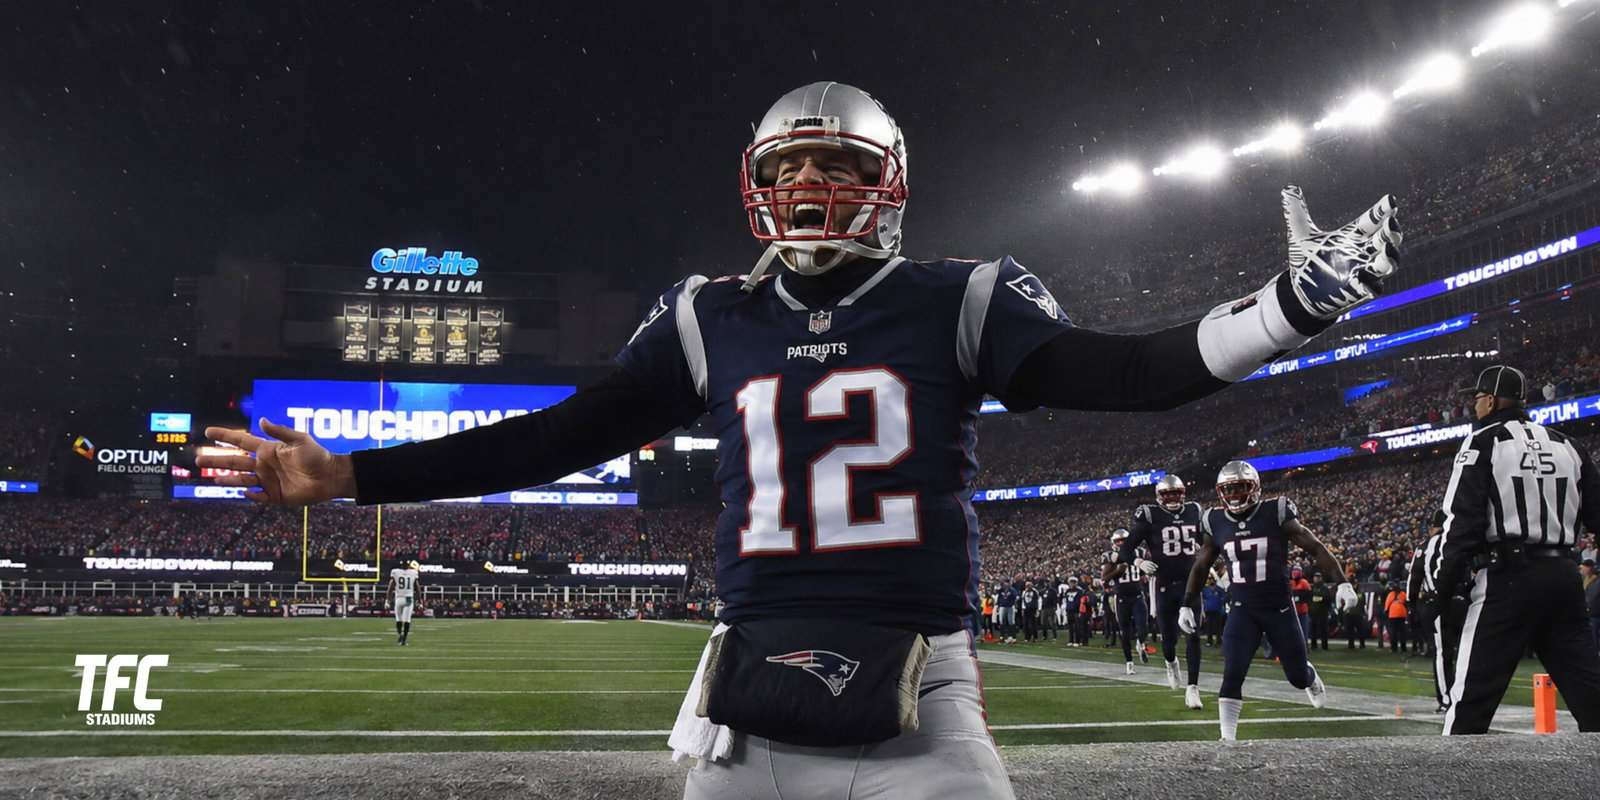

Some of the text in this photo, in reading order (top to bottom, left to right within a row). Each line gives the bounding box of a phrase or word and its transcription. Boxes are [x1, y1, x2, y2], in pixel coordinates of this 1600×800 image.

[371, 247, 479, 276] Gillette
[1444, 236, 1577, 290] TOUCHDOWN
[365, 277, 483, 293] STADIUM
[787, 342, 847, 359] PATRIOTS
[287, 407, 542, 441] TOUCHDO
[1529, 402, 1579, 425] OPTUM
[97, 449, 168, 465] OPTUM
[735, 365, 924, 557] 12
[1520, 452, 1556, 475] 45
[97, 464, 126, 473] FIELD
[128, 465, 168, 474] LOUNGE
[1161, 525, 1198, 557] 85
[568, 563, 687, 575] TOUCHDOWN
[1223, 537, 1269, 584] 17
[398, 576, 411, 590] 91
